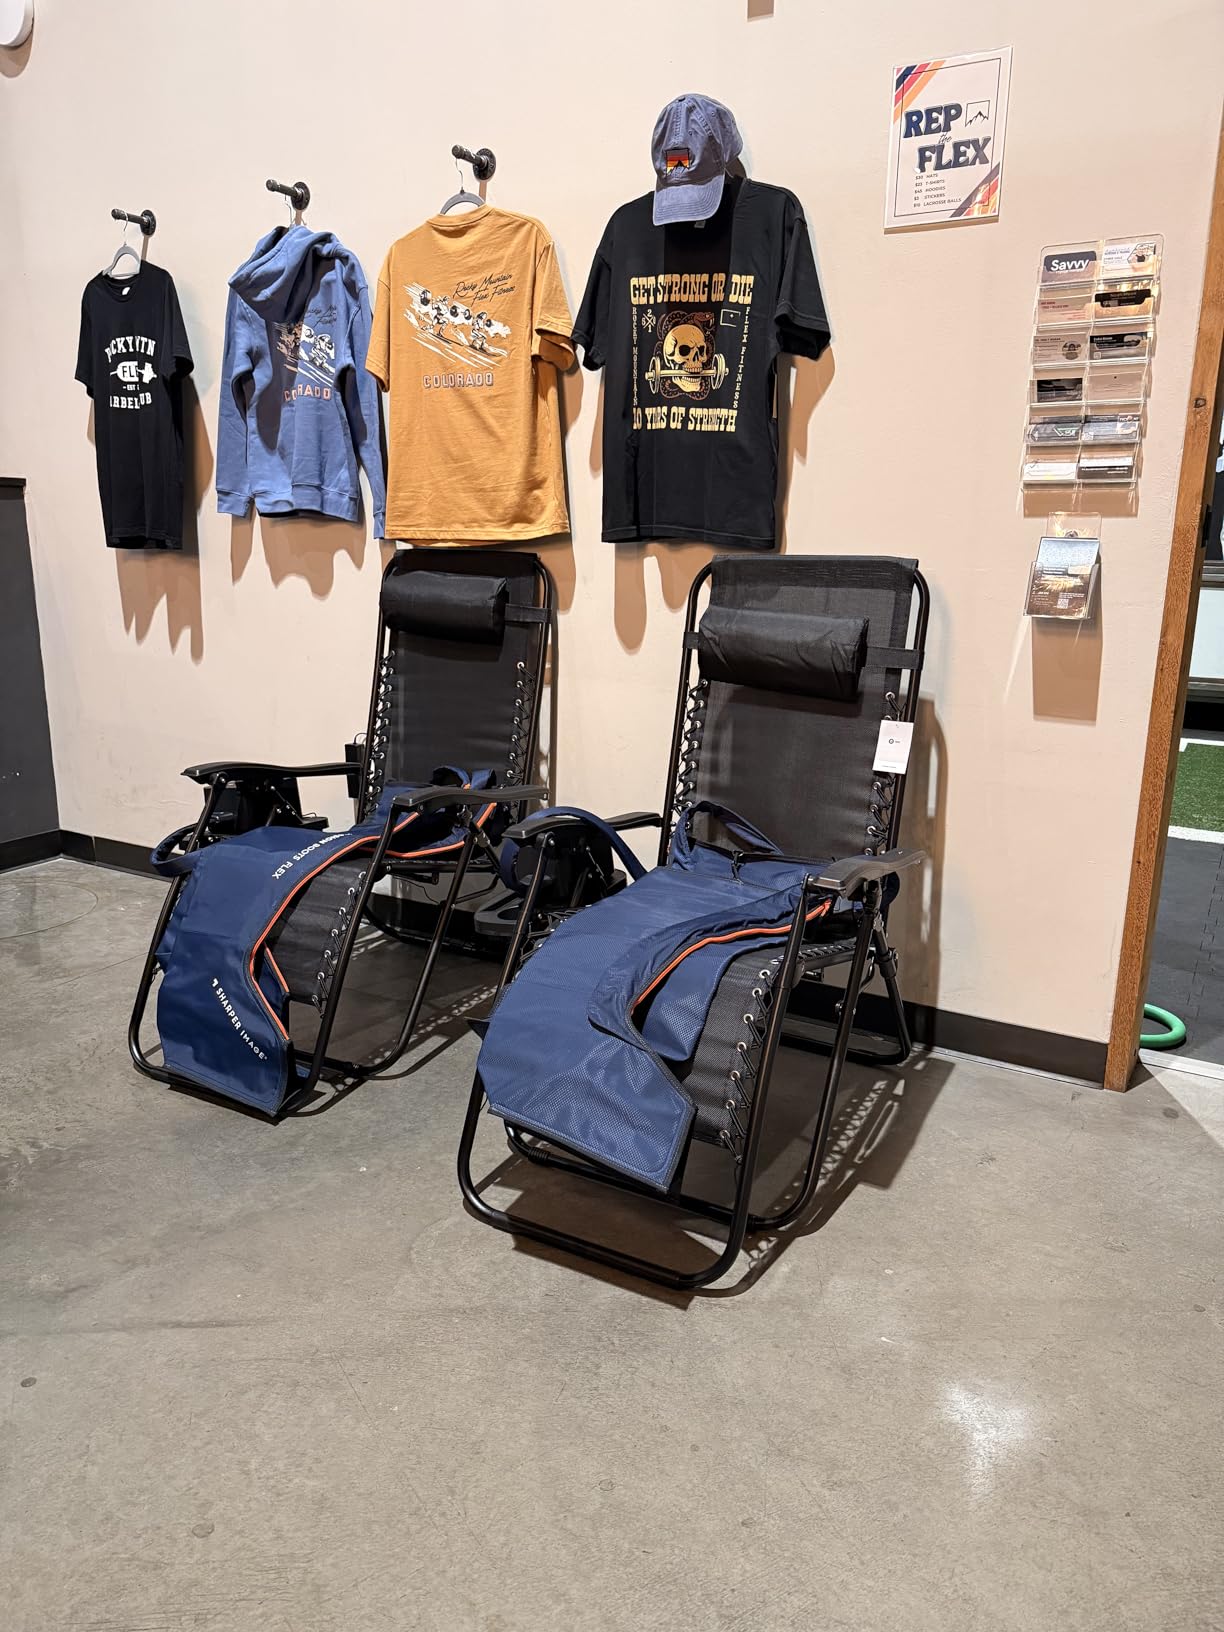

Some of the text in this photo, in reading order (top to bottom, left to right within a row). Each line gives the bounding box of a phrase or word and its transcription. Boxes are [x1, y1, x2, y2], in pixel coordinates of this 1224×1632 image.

[903, 102, 962, 139] REP
[938, 131, 953, 144] the
[916, 136, 992, 173] FLEX
[1050, 258, 1089, 272] Savvy
[452, 273, 513, 299] Rocky Mountain
[630, 272, 755, 305] GET STRONG OR DIE
[741, 306, 751, 343] FLEX
[423, 372, 494, 389] COLORADO
[732, 346, 746, 409] FITNESS
[632, 407, 642, 430] 10
[669, 405, 686, 430] OF
[271, 842, 321, 880] BOOTS FLEX
[215, 987, 242, 1030] SHARPER
